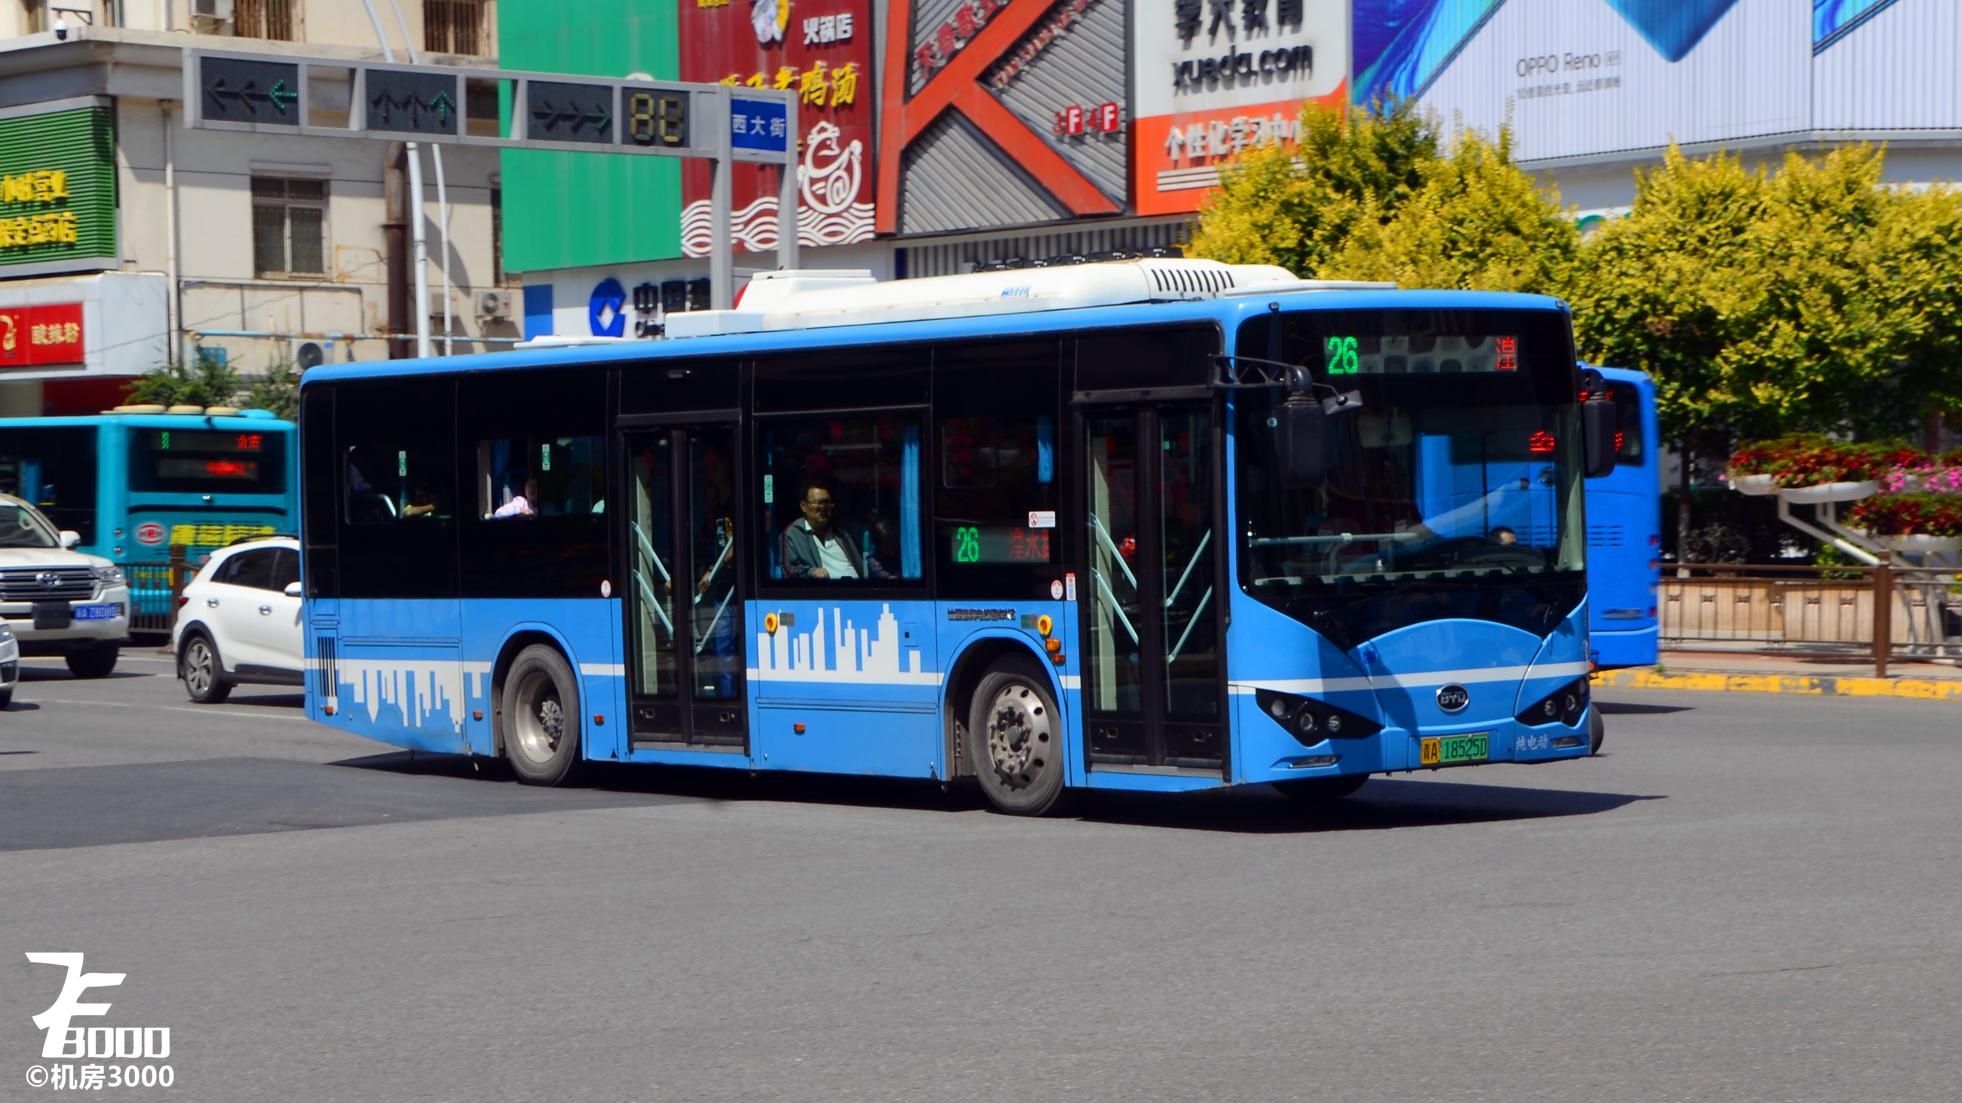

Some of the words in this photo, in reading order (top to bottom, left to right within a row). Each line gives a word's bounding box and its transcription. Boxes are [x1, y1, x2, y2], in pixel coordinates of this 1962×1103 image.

[803, 13, 853, 45] 火锅店
[1172, 45, 1313, 87] xueda.com
[1516, 55, 1559, 77] OPPO
[1563, 52, 1601, 72] Reno
[731, 113, 786, 138] 西大街
[1327, 336, 1359, 374] 26
[957, 526, 980, 562] 26
[1423, 741, 1439, 760] 青A
[1444, 737, 1488, 760] 18525D
[1516, 735, 1548, 750] 纯电动
